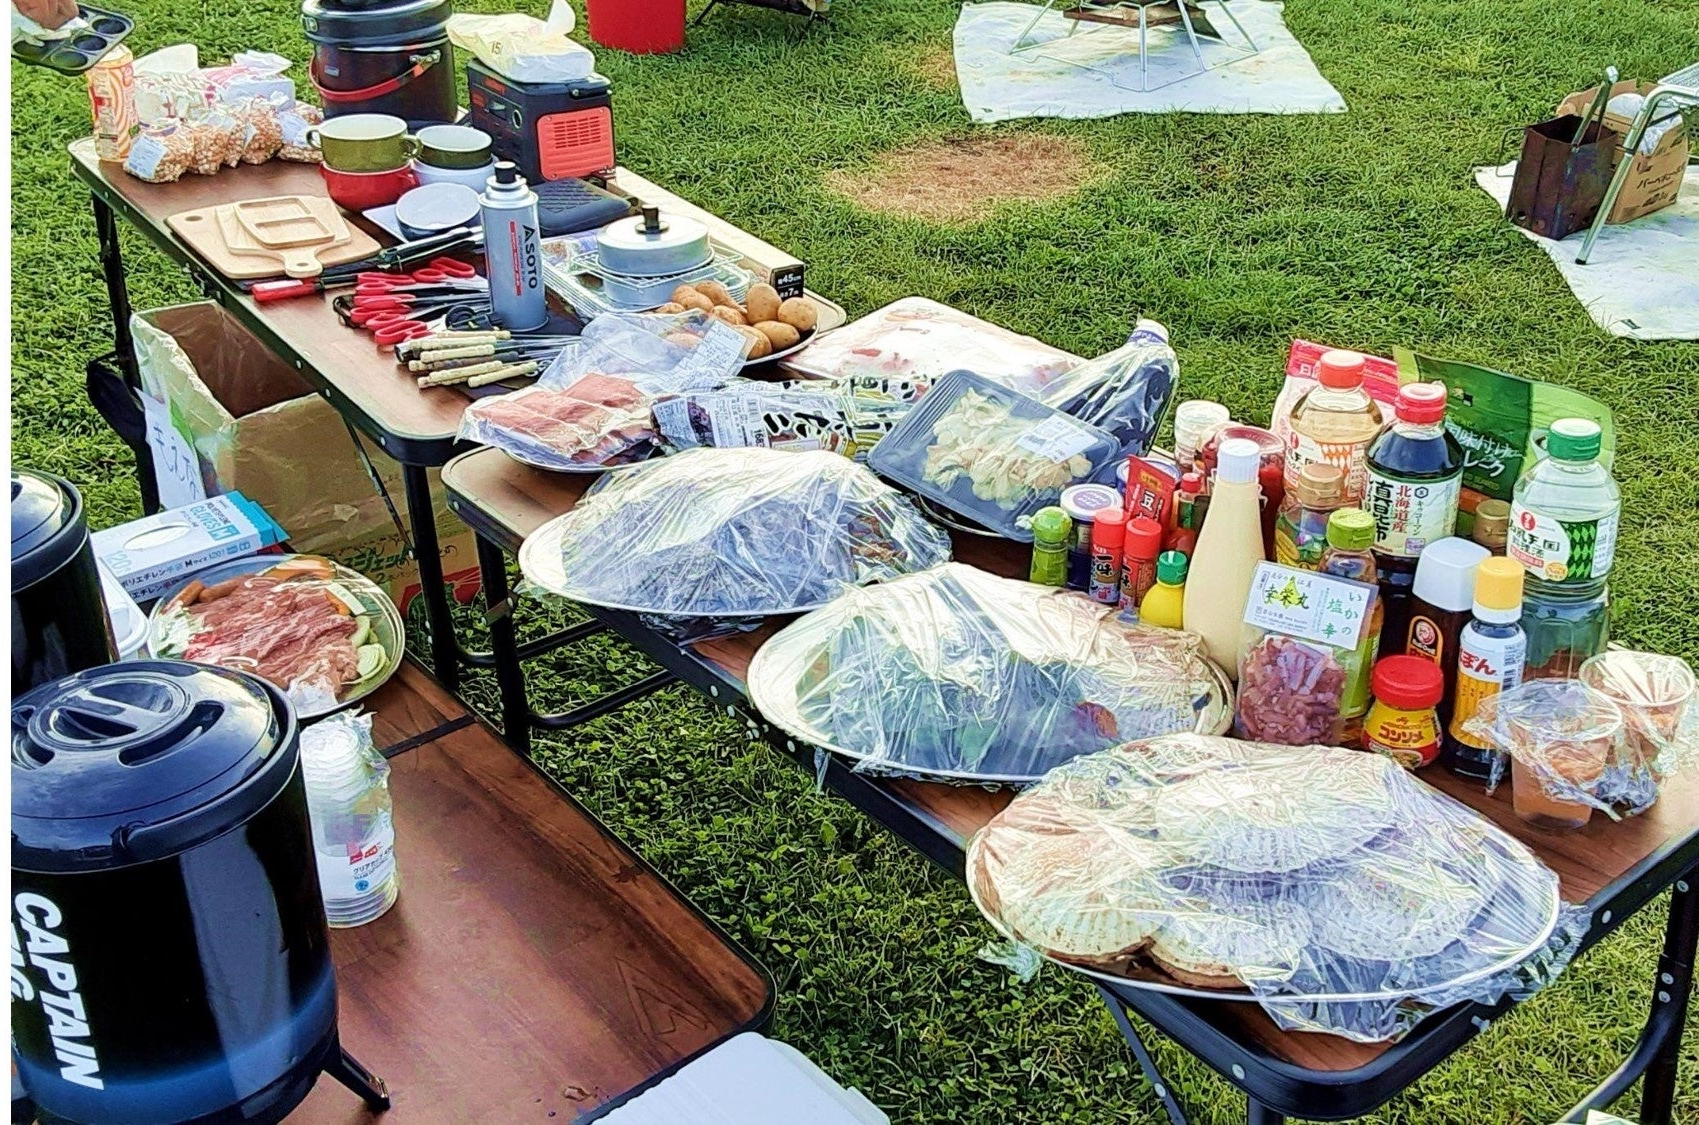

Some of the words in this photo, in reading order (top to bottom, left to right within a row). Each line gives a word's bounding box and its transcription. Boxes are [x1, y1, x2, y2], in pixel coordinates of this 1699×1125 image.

[524, 242, 539, 290] SOTO
[1392, 485, 1412, 533] 北海道産
[1341, 591, 1363, 637] いかの
[1378, 724, 1424, 744] コンソメ
[14, 892, 104, 1091] CAPTAIN
